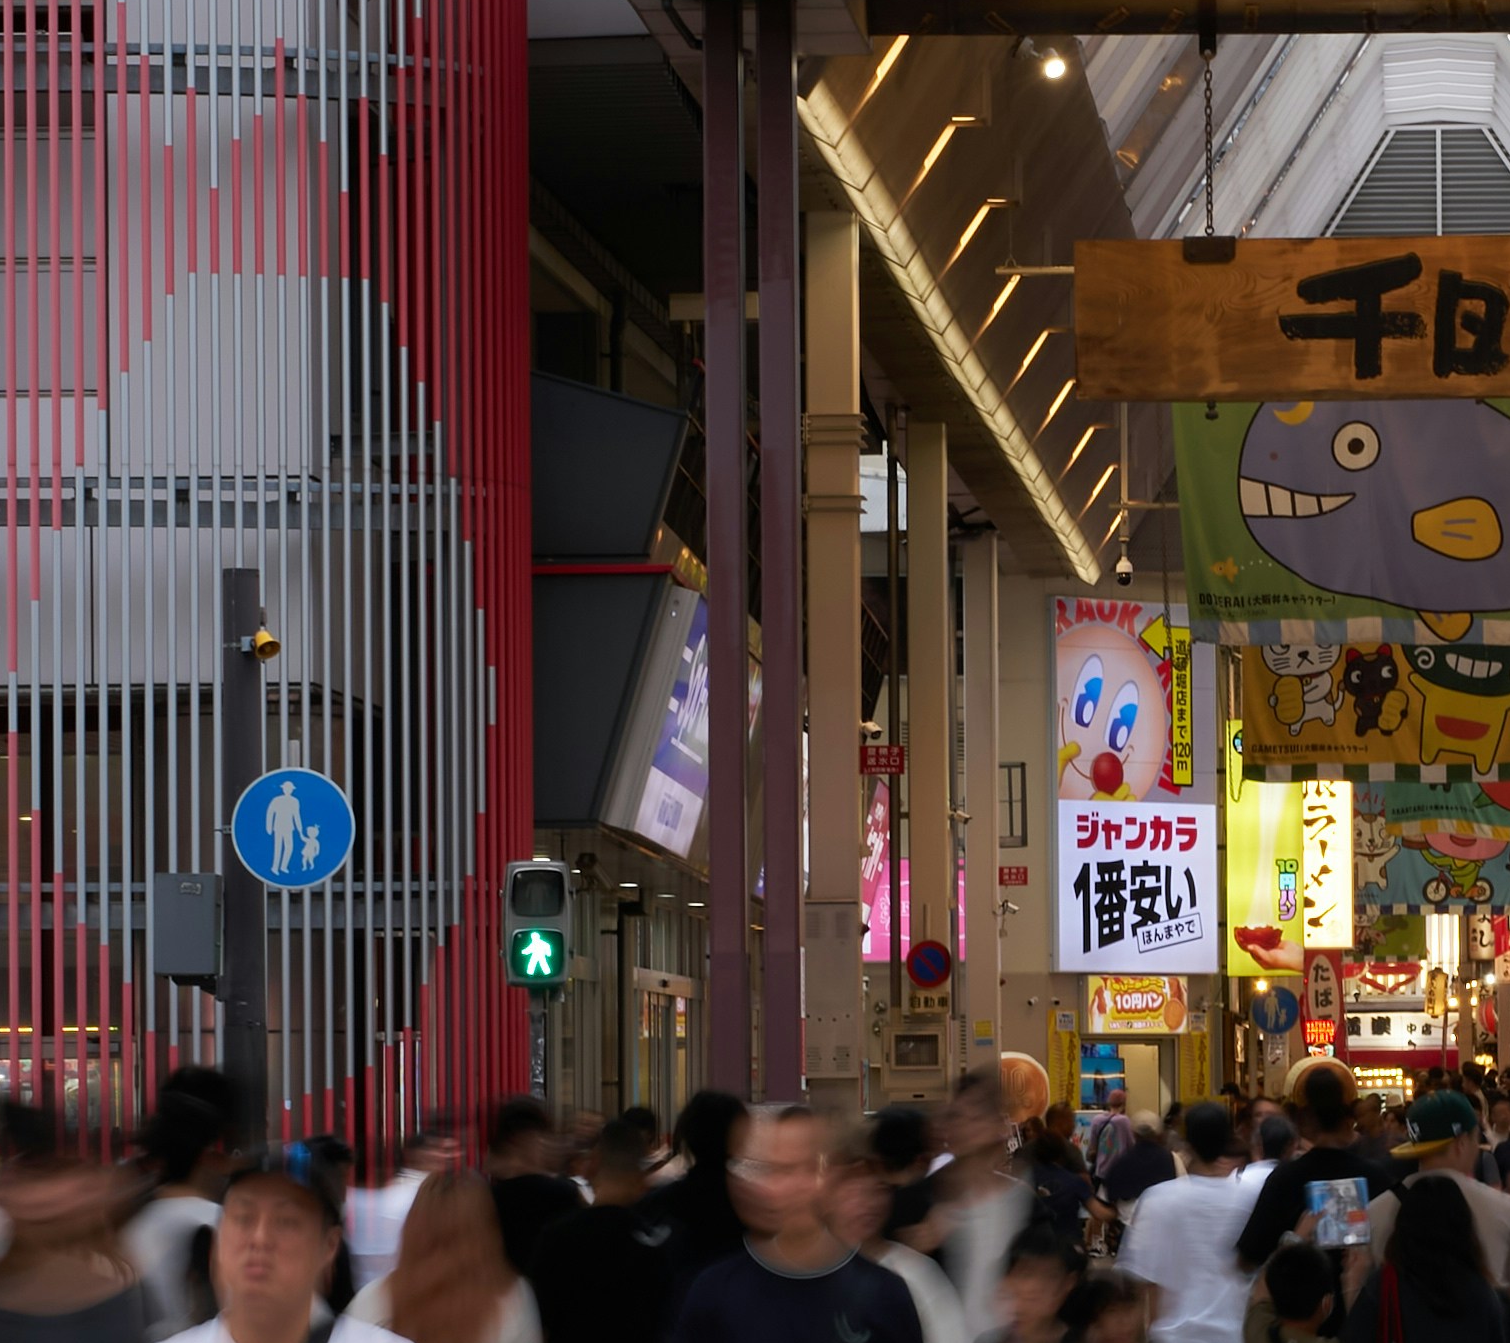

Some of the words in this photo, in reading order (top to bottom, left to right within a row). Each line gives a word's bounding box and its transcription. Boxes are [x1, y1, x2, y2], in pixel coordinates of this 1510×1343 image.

[1076, 812, 1198, 852] ジャンカラ
[1141, 919, 1196, 947] ほんまやで
[1115, 991, 1164, 1010] 10円パン
